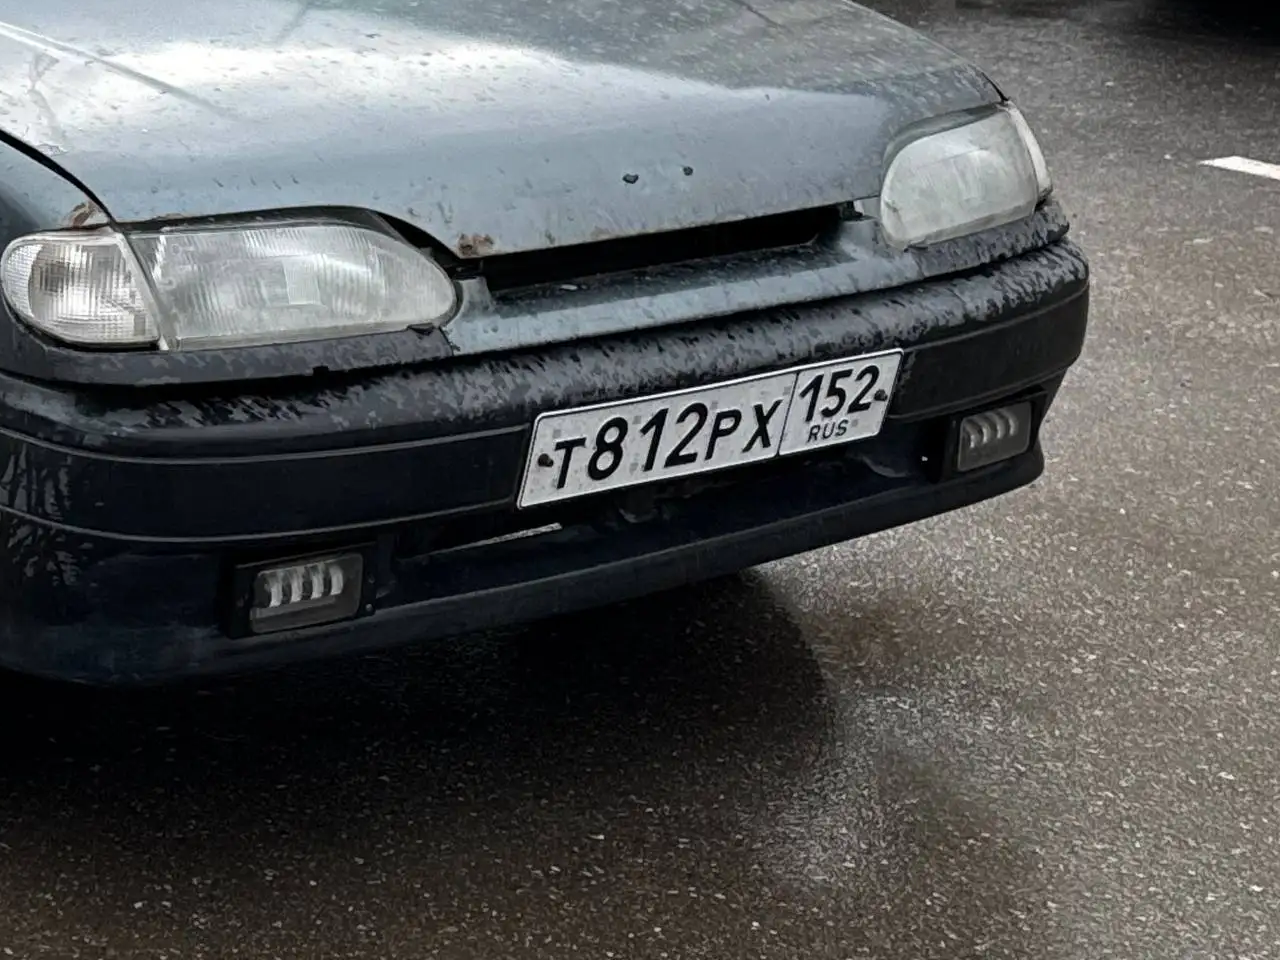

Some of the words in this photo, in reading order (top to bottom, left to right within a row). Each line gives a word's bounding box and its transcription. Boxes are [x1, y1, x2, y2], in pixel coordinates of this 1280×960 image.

[553, 398, 783, 490] Т812РХ
[798, 365, 880, 423] 152
[806, 419, 850, 444] RUS
